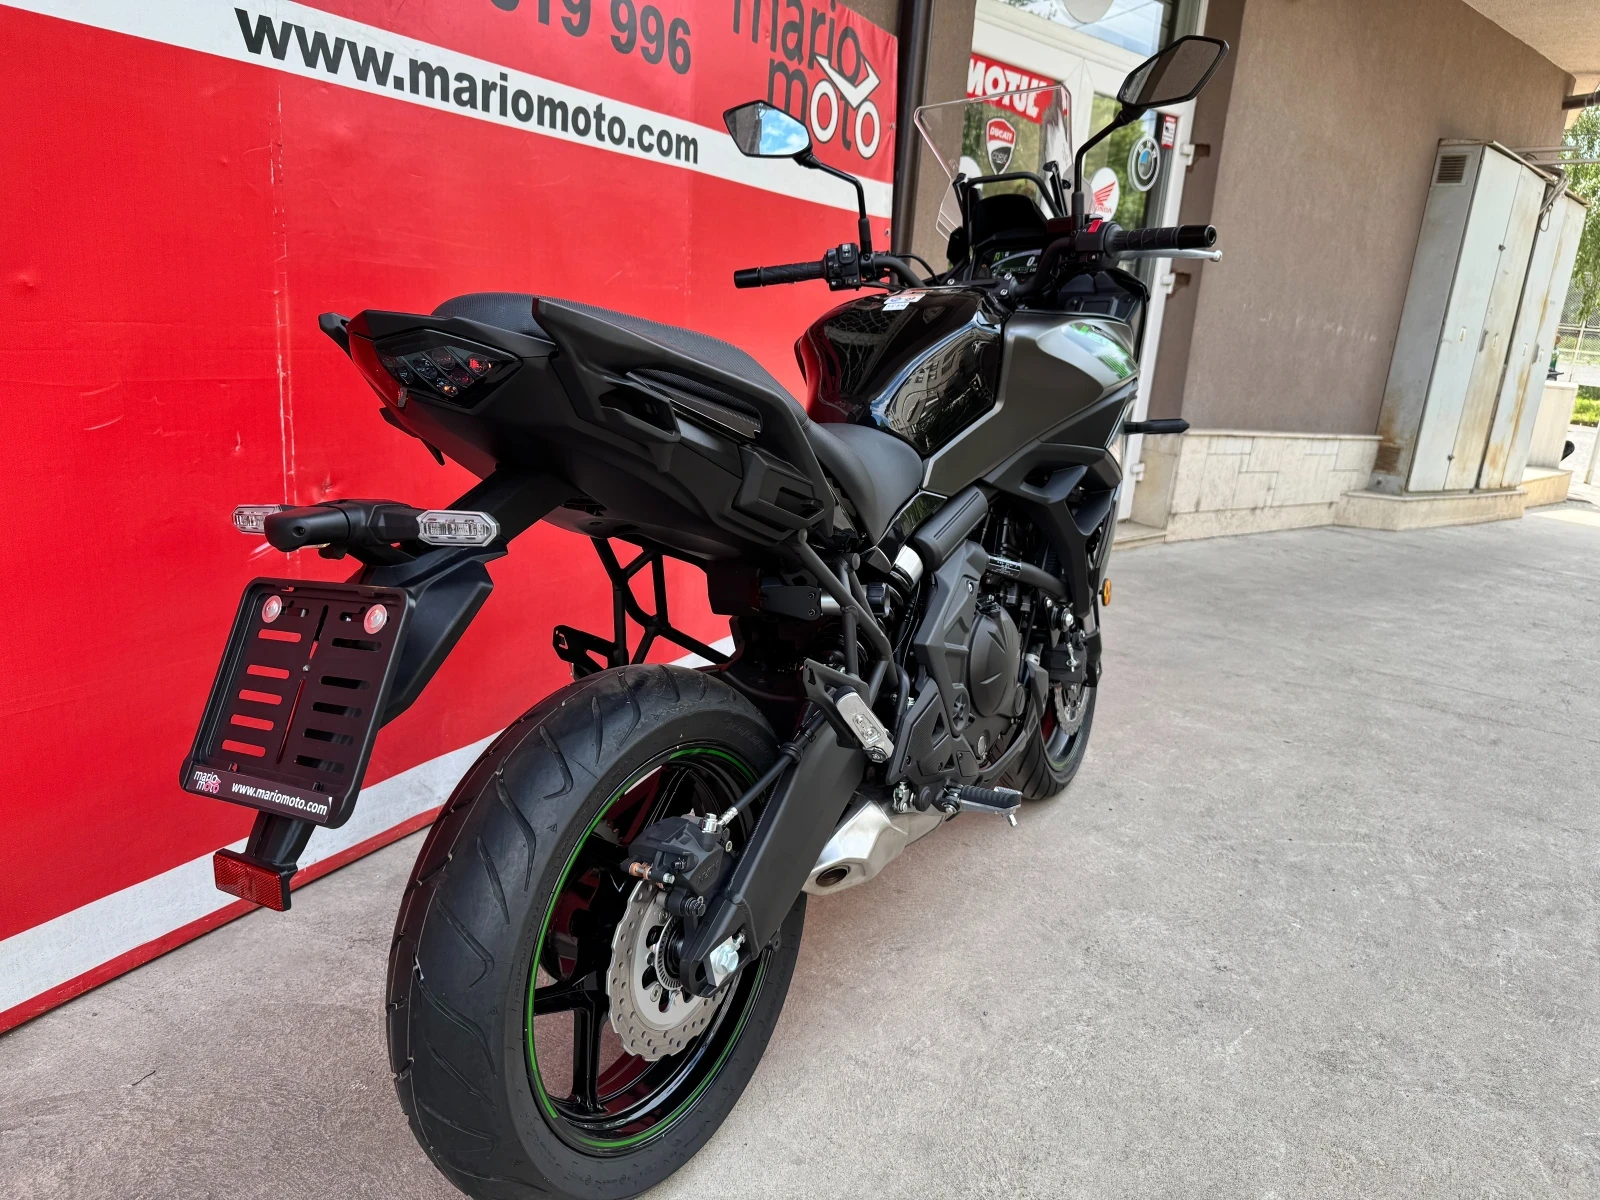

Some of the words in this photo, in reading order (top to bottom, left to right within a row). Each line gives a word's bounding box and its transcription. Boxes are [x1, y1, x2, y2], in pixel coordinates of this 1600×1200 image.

[610, 0, 692, 75] 996
[732, 0, 862, 84] mario
[234, 7, 699, 165] www.mariomoto.com
[767, 58, 881, 161] moto
[966, 58, 1048, 118] MOTUL
[989, 126, 1013, 141] DUCATI
[194, 770, 218, 783] mario
[196, 780, 220, 794] moto
[231, 782, 328, 816] www.mariomoto.com
